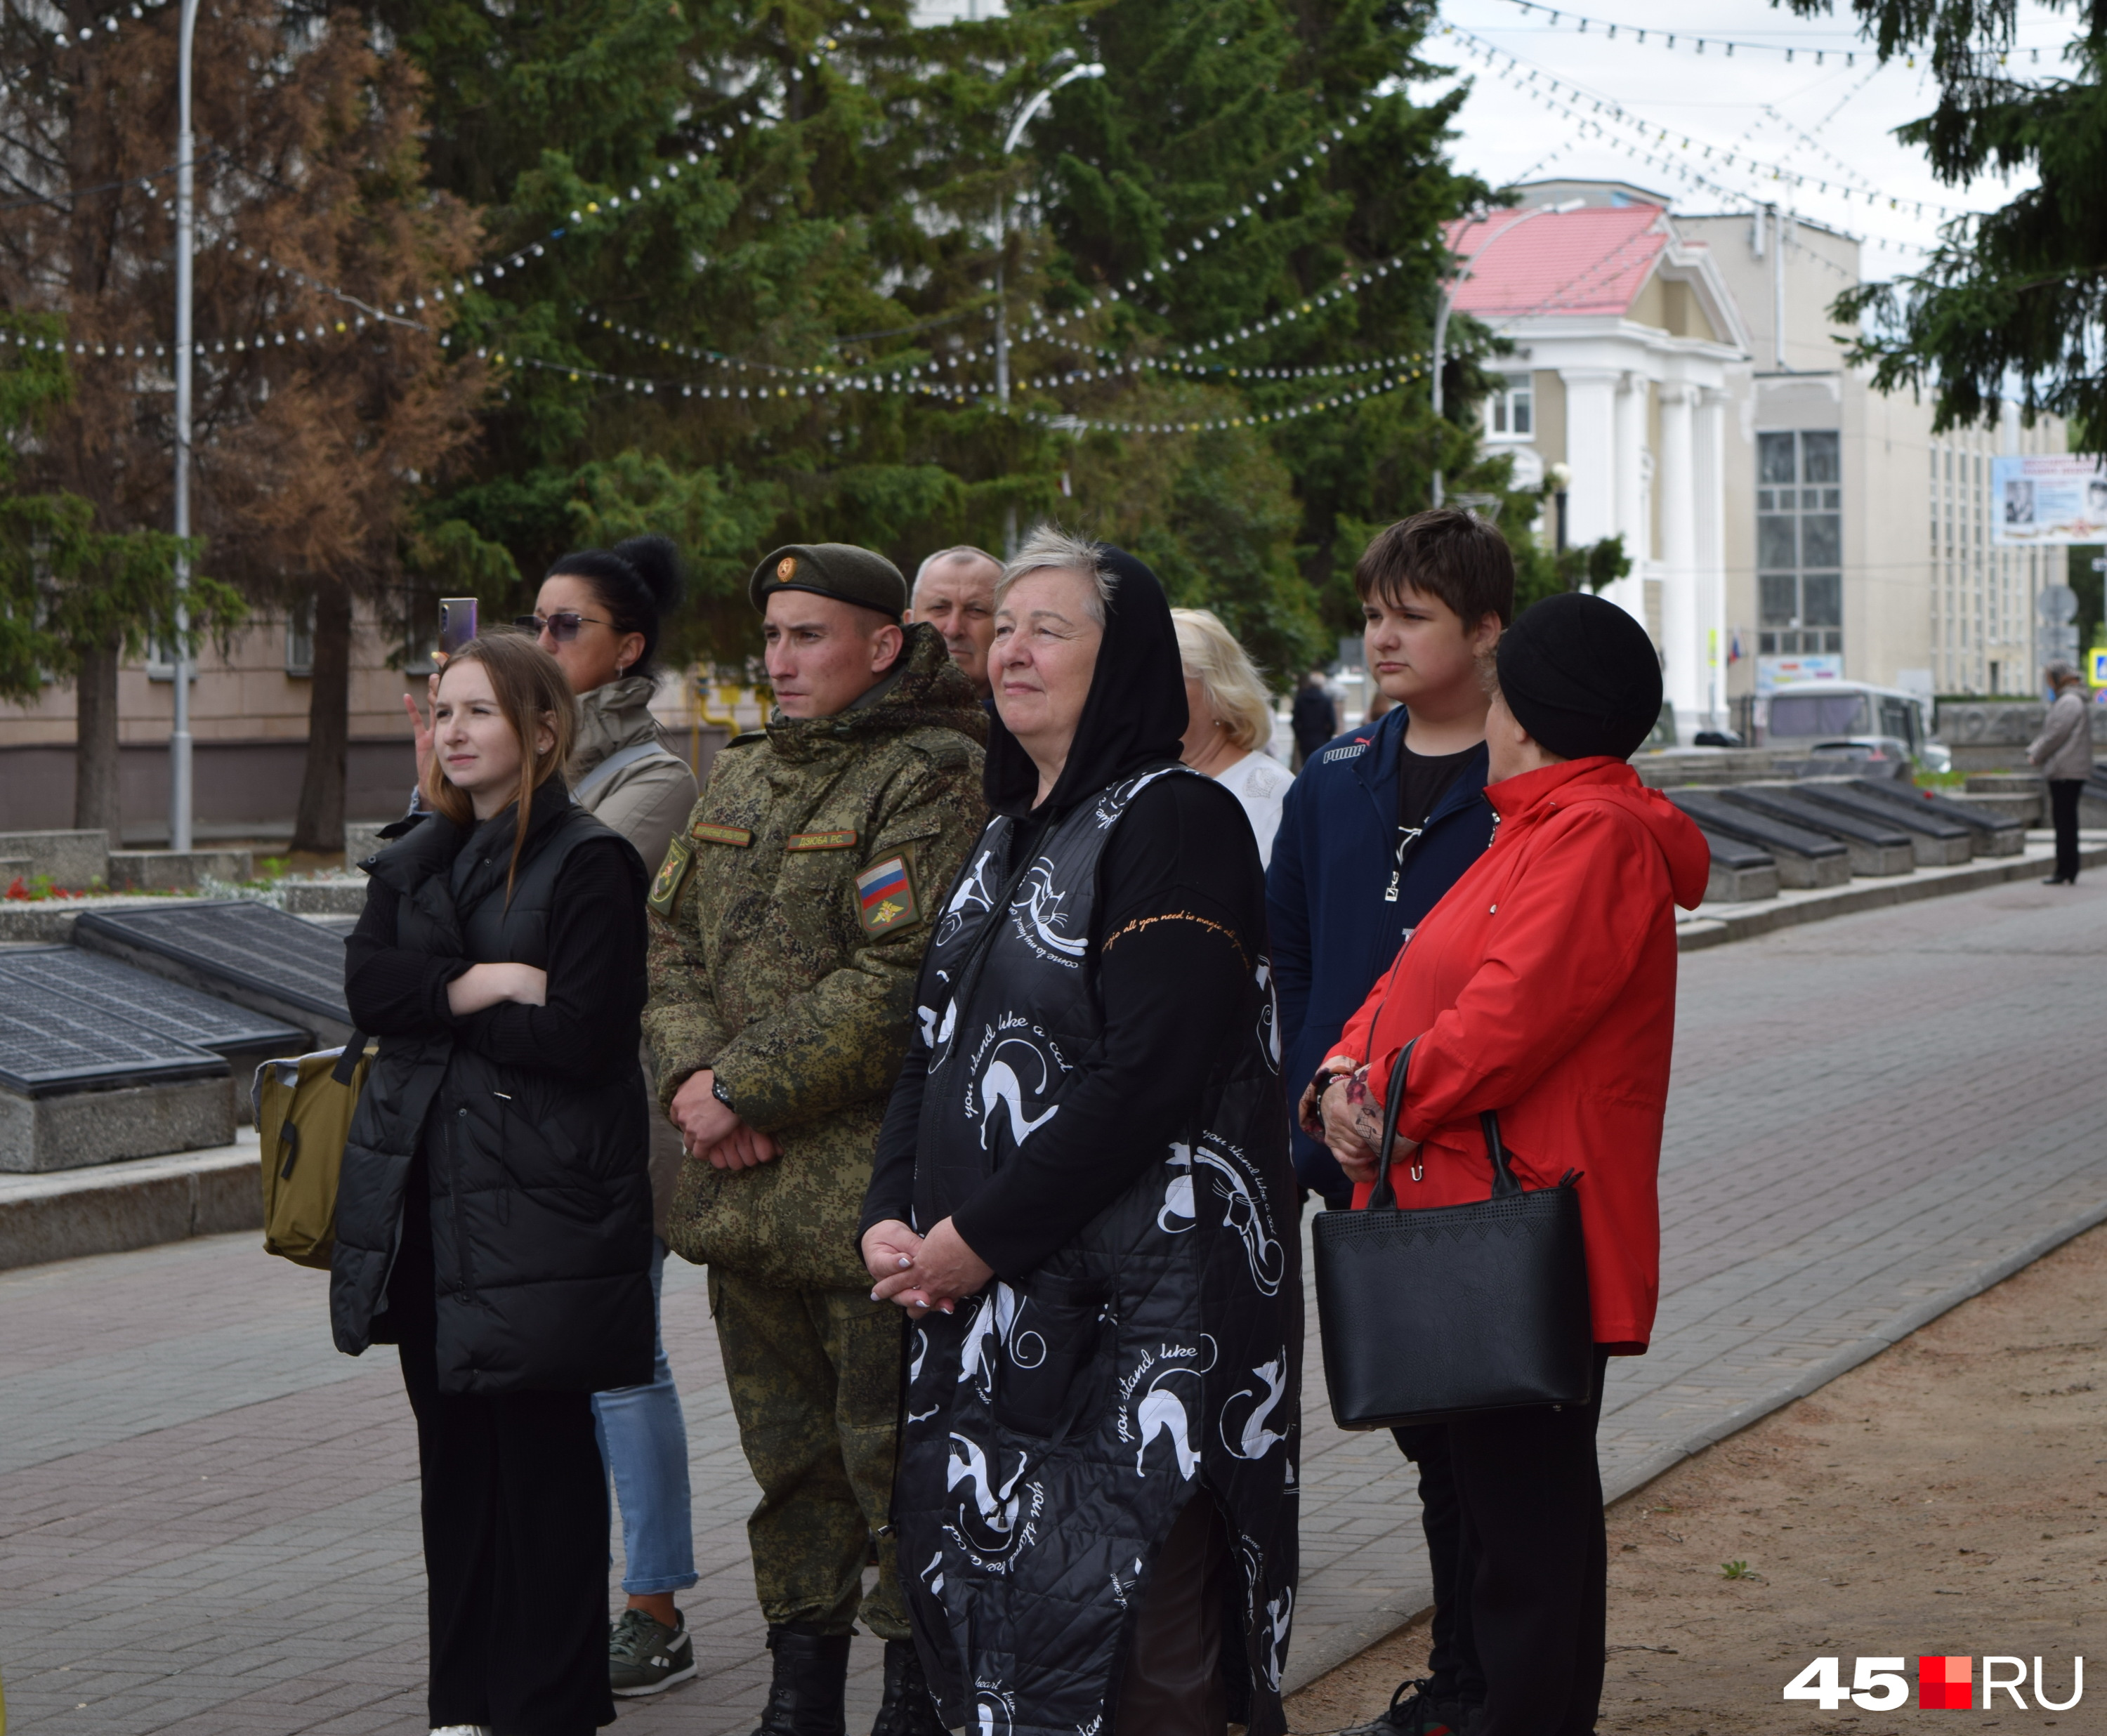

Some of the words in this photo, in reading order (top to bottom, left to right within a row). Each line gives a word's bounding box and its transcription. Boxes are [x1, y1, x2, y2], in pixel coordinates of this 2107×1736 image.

[1323, 744, 1366, 764] PUMA
[799, 836, 827, 848] ДЗЮБА
[1012, 916, 1028, 939] heart
[1123, 919, 1137, 933] all
[1139, 917, 1159, 932] you
[1161, 910, 1184, 921] need
[1196, 916, 1222, 933] magic
[1036, 947, 1047, 959] to
[1046, 953, 1078, 968] come
[998, 1011, 1028, 1030] like
[1033, 1025, 1044, 1037] a
[971, 1024, 996, 1076] stand
[1049, 1041, 1073, 1073] cat
[965, 1082, 979, 1119] you
[1202, 1129, 1228, 1146] you
[1228, 1145, 1260, 1176] stand
[1255, 1177, 1267, 1201] like
[1265, 1203, 1270, 1213] a
[1160, 1343, 1198, 1358] like
[1119, 1349, 1155, 1400] stand
[1117, 1405, 1135, 1443] you
[1025, 1481, 1044, 1518] you
[942, 1523, 967, 1551] cat
[1008, 1522, 1037, 1572] stand
[1242, 1534, 1260, 1550] come
[970, 1554, 982, 1566] a
[1110, 1573, 1123, 1596] come
[975, 1675, 1002, 1690] heart
